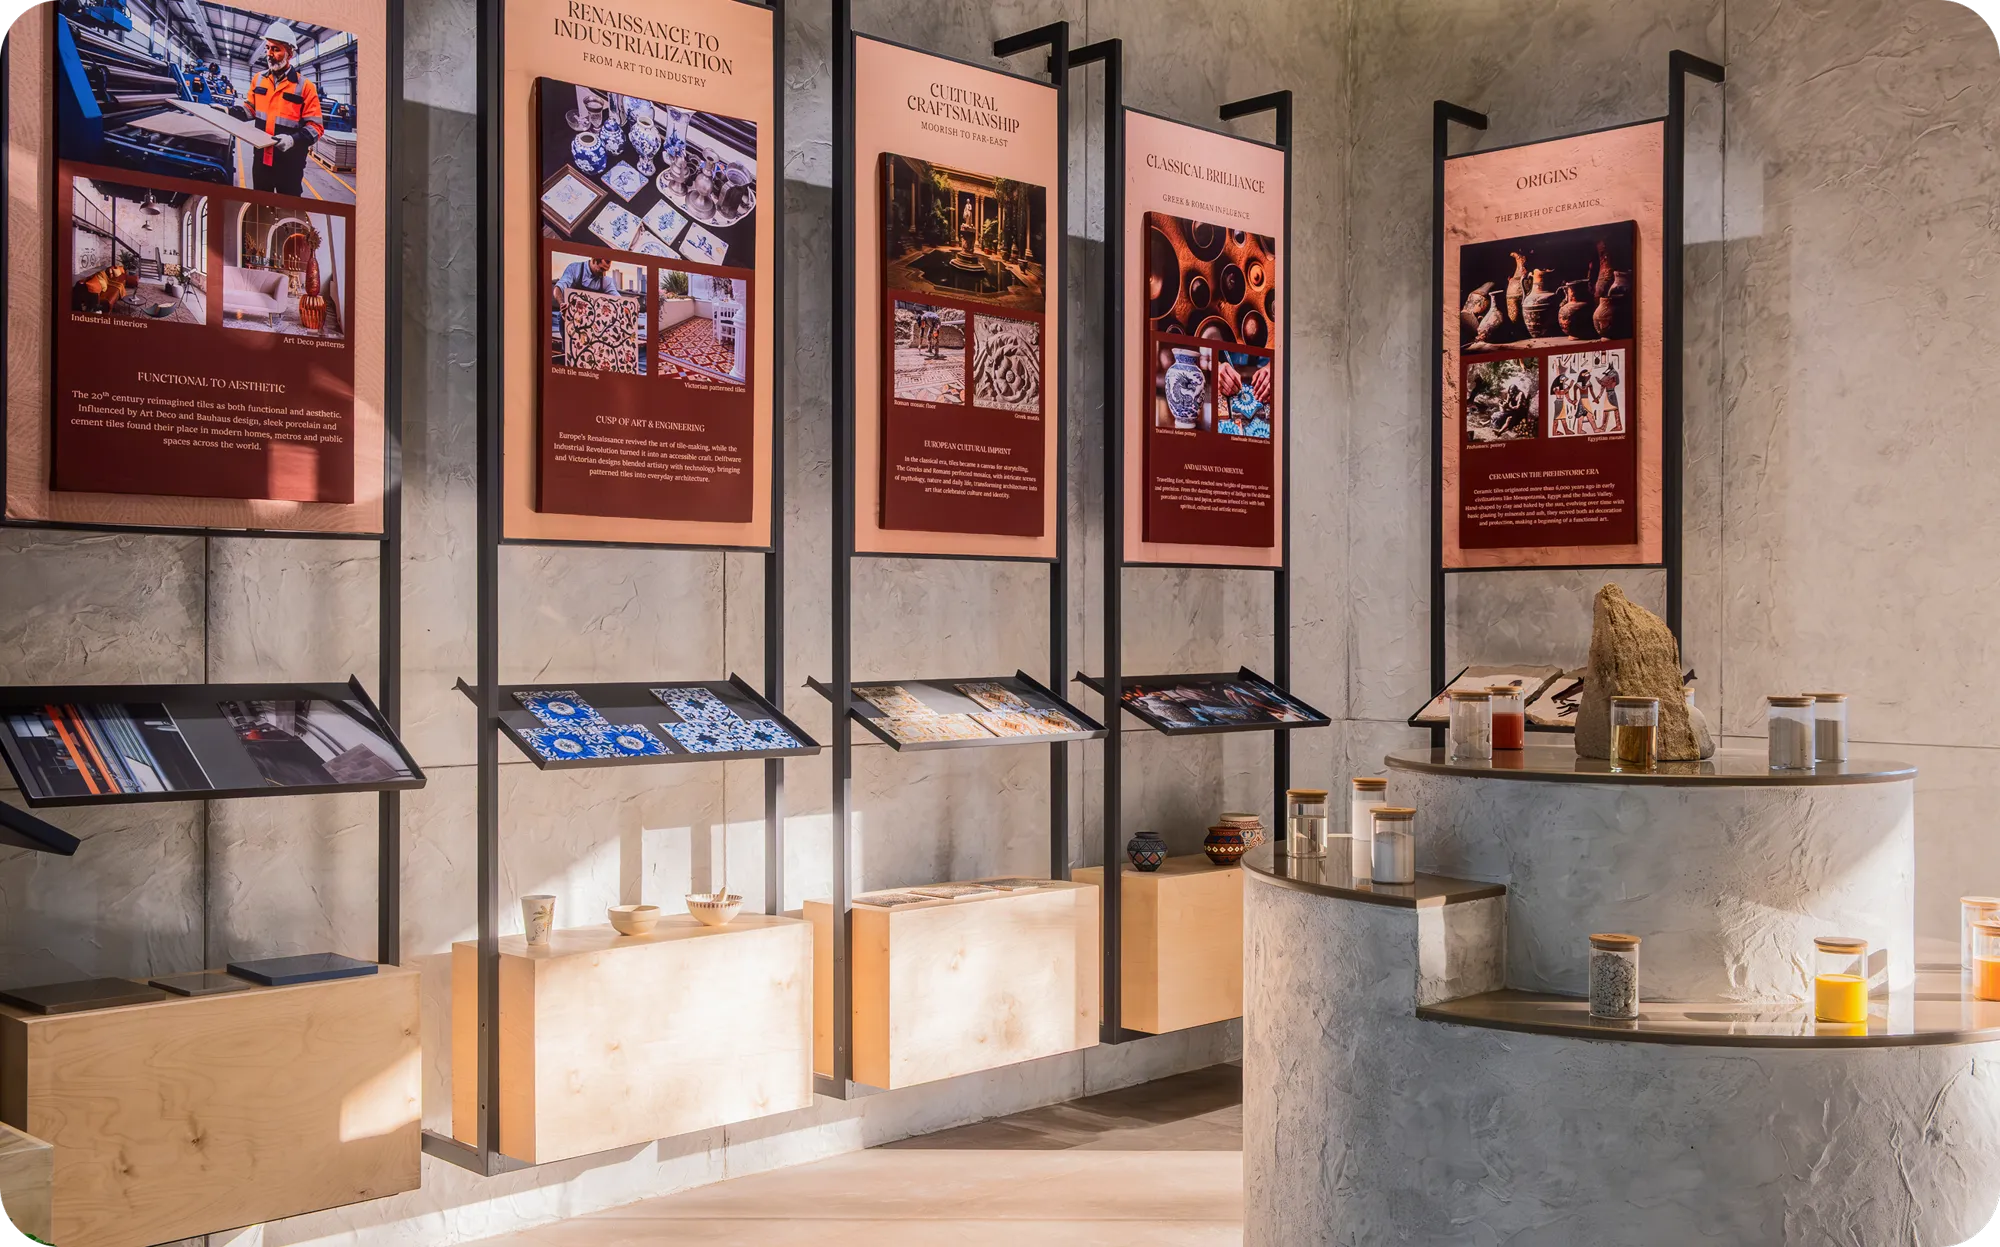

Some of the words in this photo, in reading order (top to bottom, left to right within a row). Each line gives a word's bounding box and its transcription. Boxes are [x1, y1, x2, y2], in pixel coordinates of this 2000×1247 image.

[569, 0, 693, 45] RENAISSANCE
[694, 30, 719, 51] TO
[555, 19, 732, 74] INDUSTRIALIZATION
[583, 52, 613, 67] FROM
[616, 59, 636, 72] ART
[639, 64, 653, 75] TO
[655, 68, 706, 87] INDUSTRY
[930, 82, 998, 111] CULTURAL
[907, 95, 1020, 133] CRAFTSMANSHIP
[921, 122, 958, 136] MOORISH
[960, 130, 971, 139] TO
[972, 132, 1009, 147] FAR-EAST
[1146, 154, 1204, 179] CLASSICAL
[1207, 168, 1265, 193] BRILLIANCE
[1517, 167, 1578, 189] ORIGINS
[1162, 193, 1185, 205] GREEK
[1185, 198, 1190, 206] &
[1191, 200, 1214, 211] ROMAN
[1215, 205, 1250, 219] INFLUENCE
[1495, 213, 1513, 223] THE
[1514, 208, 1540, 219] BIRTH
[1542, 206, 1554, 215] OF
[1555, 198, 1601, 212] CERAMICS
[72, 314, 111, 325] Industrial
[114, 317, 148, 328] interiors
[284, 336, 295, 344] Art
[297, 337, 315, 346] Deco
[316, 338, 345, 350] patterns
[138, 371, 208, 387] FUNCTIONAL
[210, 377, 226, 389] TO
[229, 379, 285, 394] AESTHETIC
[552, 367, 566, 375] Delft
[567, 368, 577, 376] tile
[578, 369, 599, 380] making
[684, 382, 708, 390] Victorian
[709, 383, 734, 393] patterned
[72, 390, 89, 400] The
[112, 393, 145, 406] century
[147, 396, 195, 410] reimagined
[197, 399, 214, 409] tiles
[228, 402, 246, 411] both
[248, 403, 288, 414] functional
[290, 406, 304, 416] and
[306, 407, 342, 419] aesthetic.
[79, 404, 125, 416] Influenced
[127, 407, 138, 419] by
[140, 408, 154, 418] Art
[156, 409, 177, 419] Deco
[179, 411, 194, 420] and
[197, 412, 231, 423] Bauhaus
[233, 415, 261, 427] design,
[263, 417, 284, 426] sleek
[286, 418, 321, 431] porcelain
[323, 421, 337, 430] and
[596, 415, 617, 425] CUSP
[618, 417, 630, 426] OF
[631, 418, 647, 428] ART
[648, 419, 654, 428] &
[655, 420, 705, 432] ENGINEERING
[71, 417, 103, 427] cement
[106, 419, 125, 429] tiles
[127, 420, 152, 430] found
[154, 422, 175, 432] their
[177, 423, 198, 435] place
[211, 425, 242, 436] modern
[245, 428, 273, 440] homes,
[275, 429, 302, 439] metros
[304, 431, 318, 440] and
[320, 432, 343, 444] public
[163, 438, 191, 448] spaces
[221, 441, 234, 449] the
[236, 441, 262, 450] world.
[554, 442, 585, 451] Industrial
[586, 444, 619, 454] Revolution
[620, 447, 640, 455] turned
[669, 450, 697, 459] accessible
[698, 452, 713, 460] craft.
[715, 453, 742, 462] Delftware
[587, 434, 624, 443] Renaissance
[625, 437, 647, 445] revived
[648, 438, 658, 446] the
[659, 439, 668, 447] art
[677, 440, 711, 452] tile-making,
[712, 443, 727, 451] while
[728, 444, 738, 452] the
[568, 454, 597, 463] Victorian
[598, 456, 621, 467] designs
[622, 458, 646, 466] blended
[647, 460, 669, 470] artistry
[670, 461, 684, 469] with
[684, 462, 716, 473] technology,
[717, 464, 741, 475] bringing
[589, 468, 619, 479] patterned
[620, 470, 633, 478] tiles
[647, 471, 674, 482] everyday
[675, 473, 710, 482] architecture.
